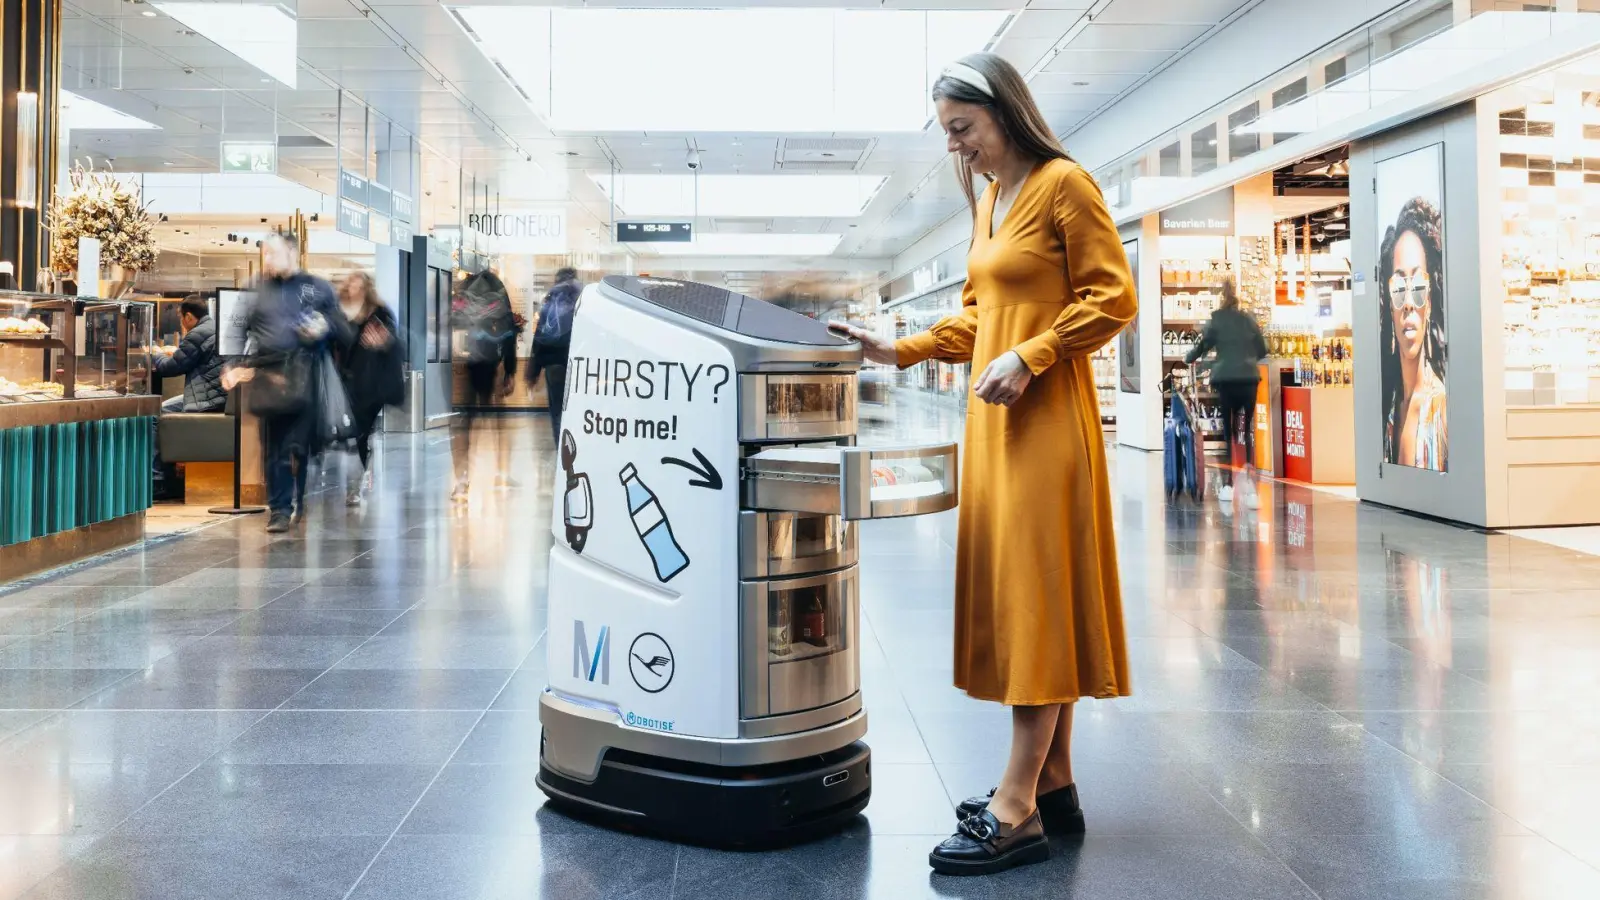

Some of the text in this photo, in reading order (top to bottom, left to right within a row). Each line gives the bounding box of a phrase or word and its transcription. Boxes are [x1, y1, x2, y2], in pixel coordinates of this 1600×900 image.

[1164, 219, 1230, 228] Bavarian Beer
[574, 357, 729, 403] THIRSTY?
[584, 409, 677, 443] Stop me!
[1286, 410, 1304, 429] DEAL
[1287, 443, 1305, 457] MONTH
[627, 711, 673, 730] ROBOTISE
